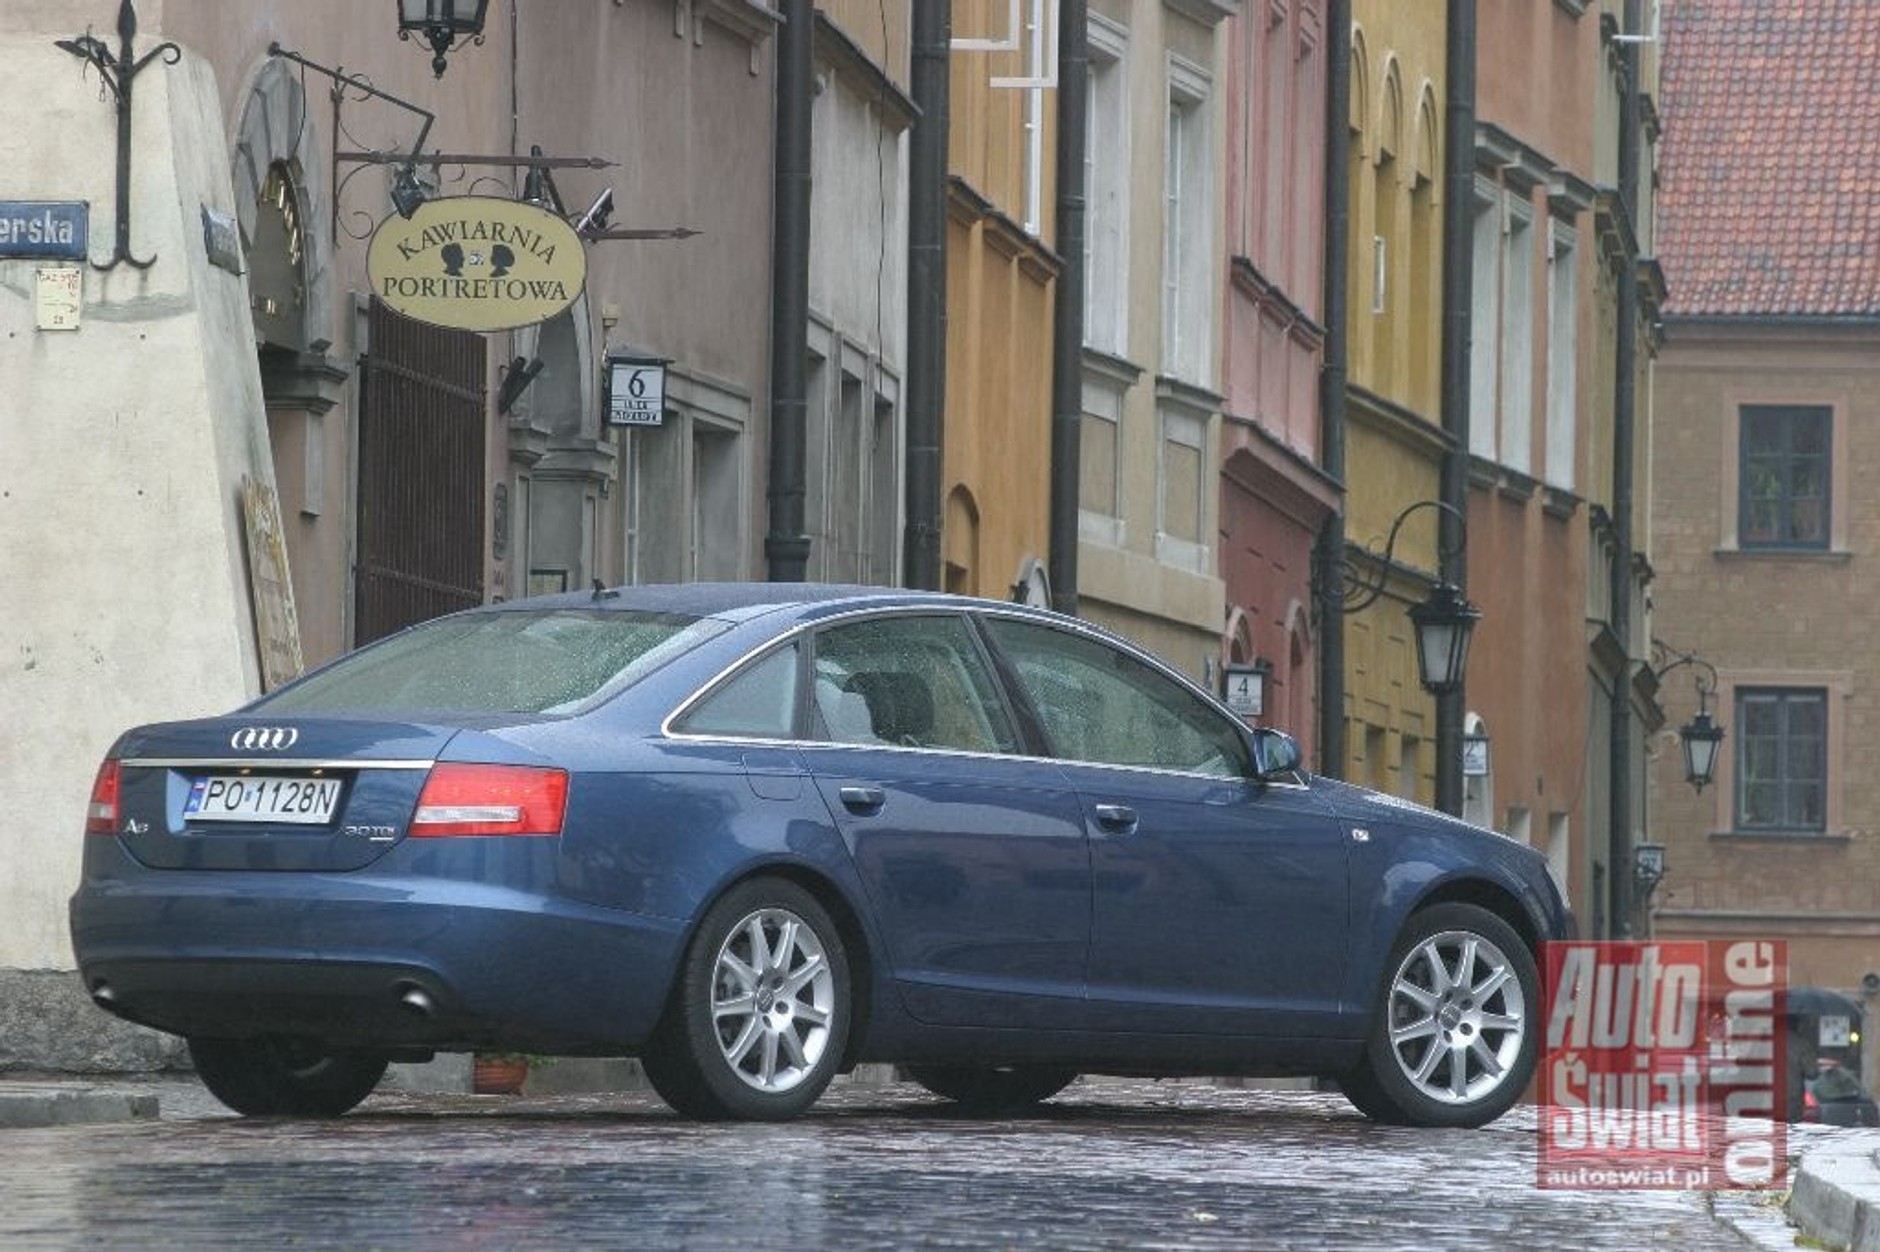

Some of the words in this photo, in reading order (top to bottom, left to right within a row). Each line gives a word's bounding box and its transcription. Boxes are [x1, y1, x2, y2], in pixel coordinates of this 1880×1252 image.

[0, 209, 73, 244] erska
[396, 220, 556, 266] KAWIARNIA
[382, 276, 569, 301] PORTRETOWA
[628, 369, 646, 398] 6
[1237, 676, 1248, 697] 4
[203, 780, 245, 811] PO
[255, 781, 337, 814] 1128N
